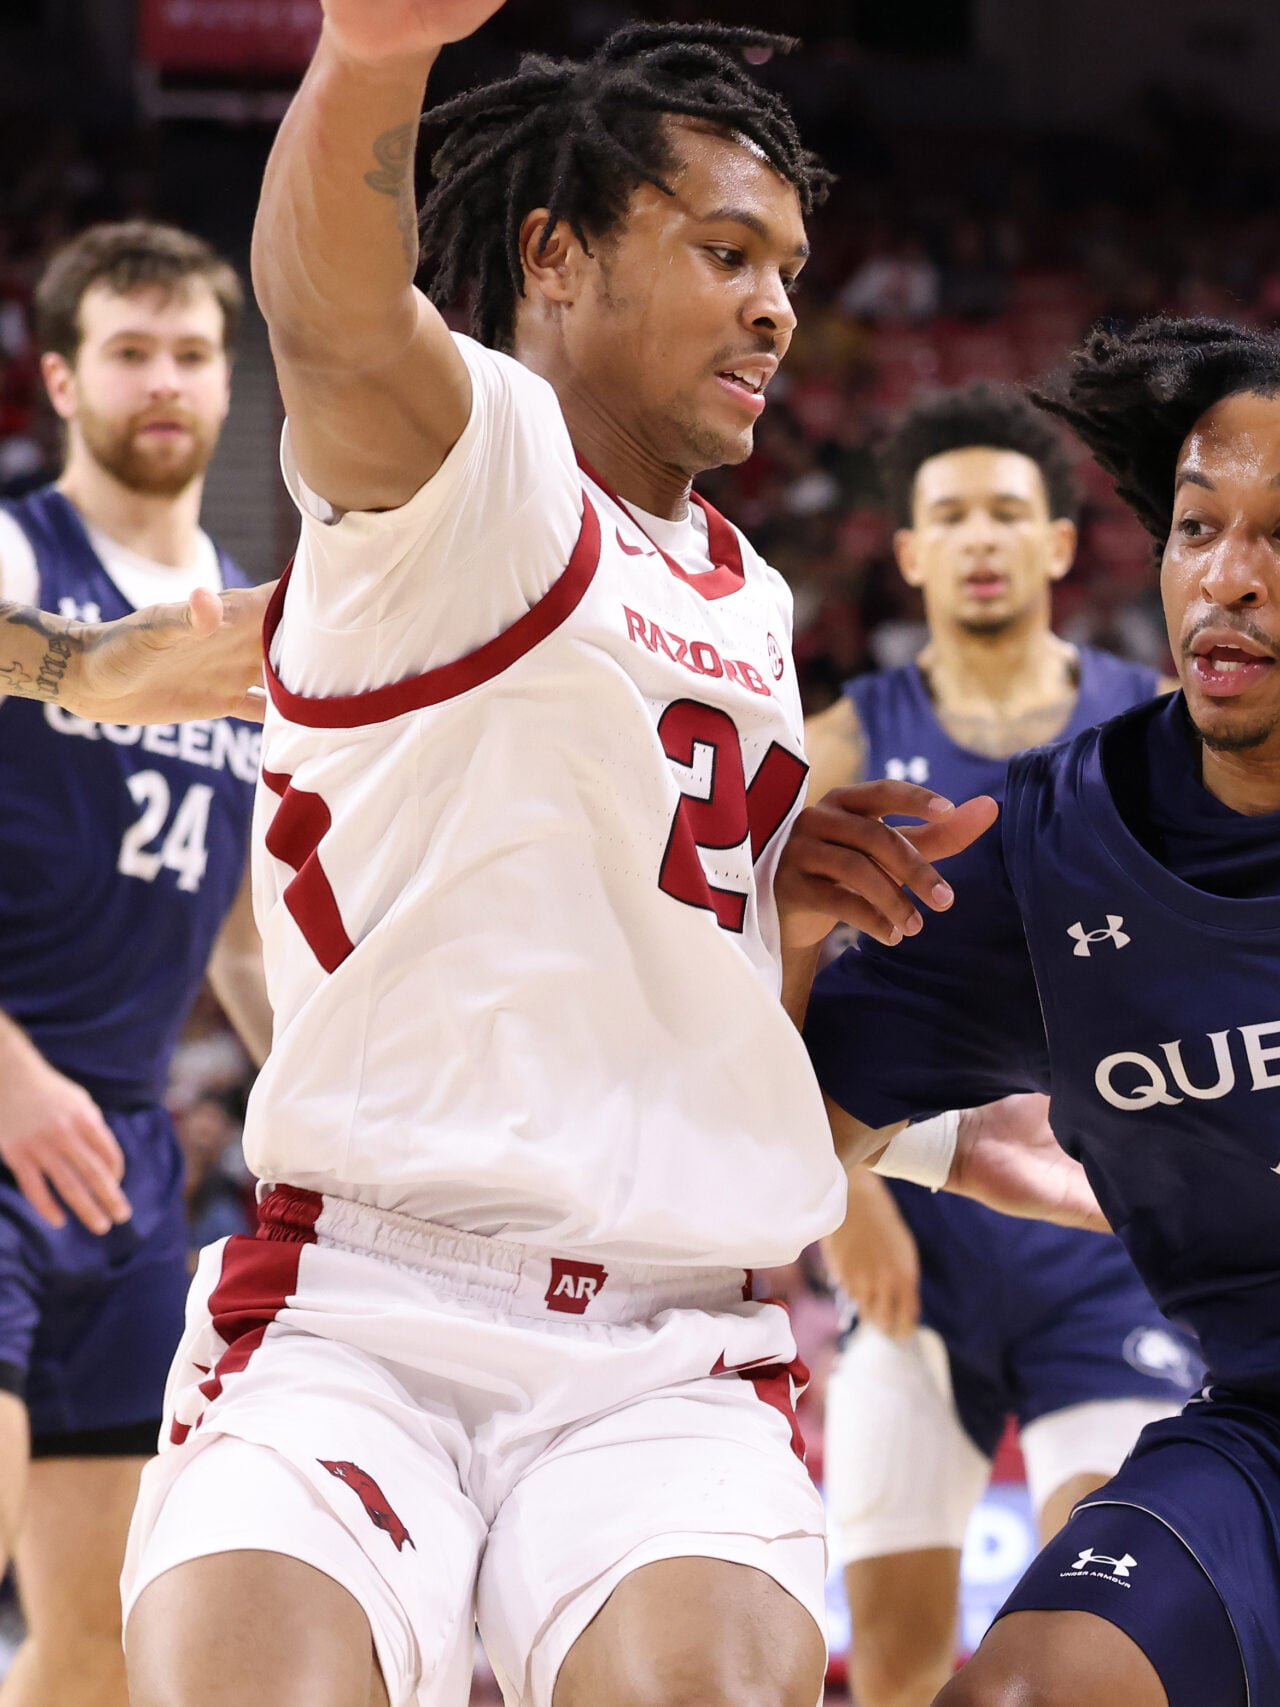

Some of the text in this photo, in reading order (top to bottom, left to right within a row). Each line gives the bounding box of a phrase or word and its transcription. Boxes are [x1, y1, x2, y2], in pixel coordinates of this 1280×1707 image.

[117, 769, 214, 893] 24
[552, 1274, 597, 1300] AR
[1090, 1571, 1131, 1588] ARMOUR
